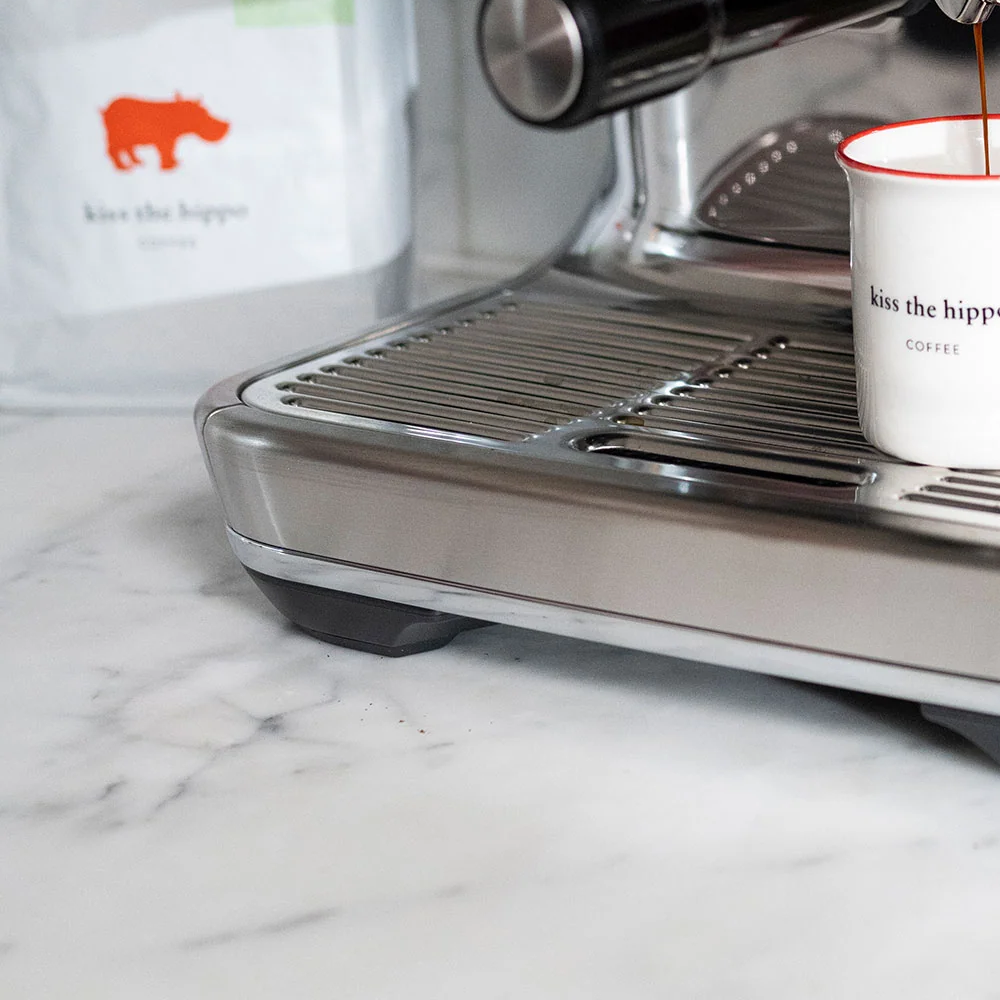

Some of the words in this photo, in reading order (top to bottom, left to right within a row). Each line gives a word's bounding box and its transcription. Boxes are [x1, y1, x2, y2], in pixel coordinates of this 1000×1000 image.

[870, 285, 900, 312] kiss
[906, 295, 937, 319] the
[905, 338, 960, 356] COFFEE
